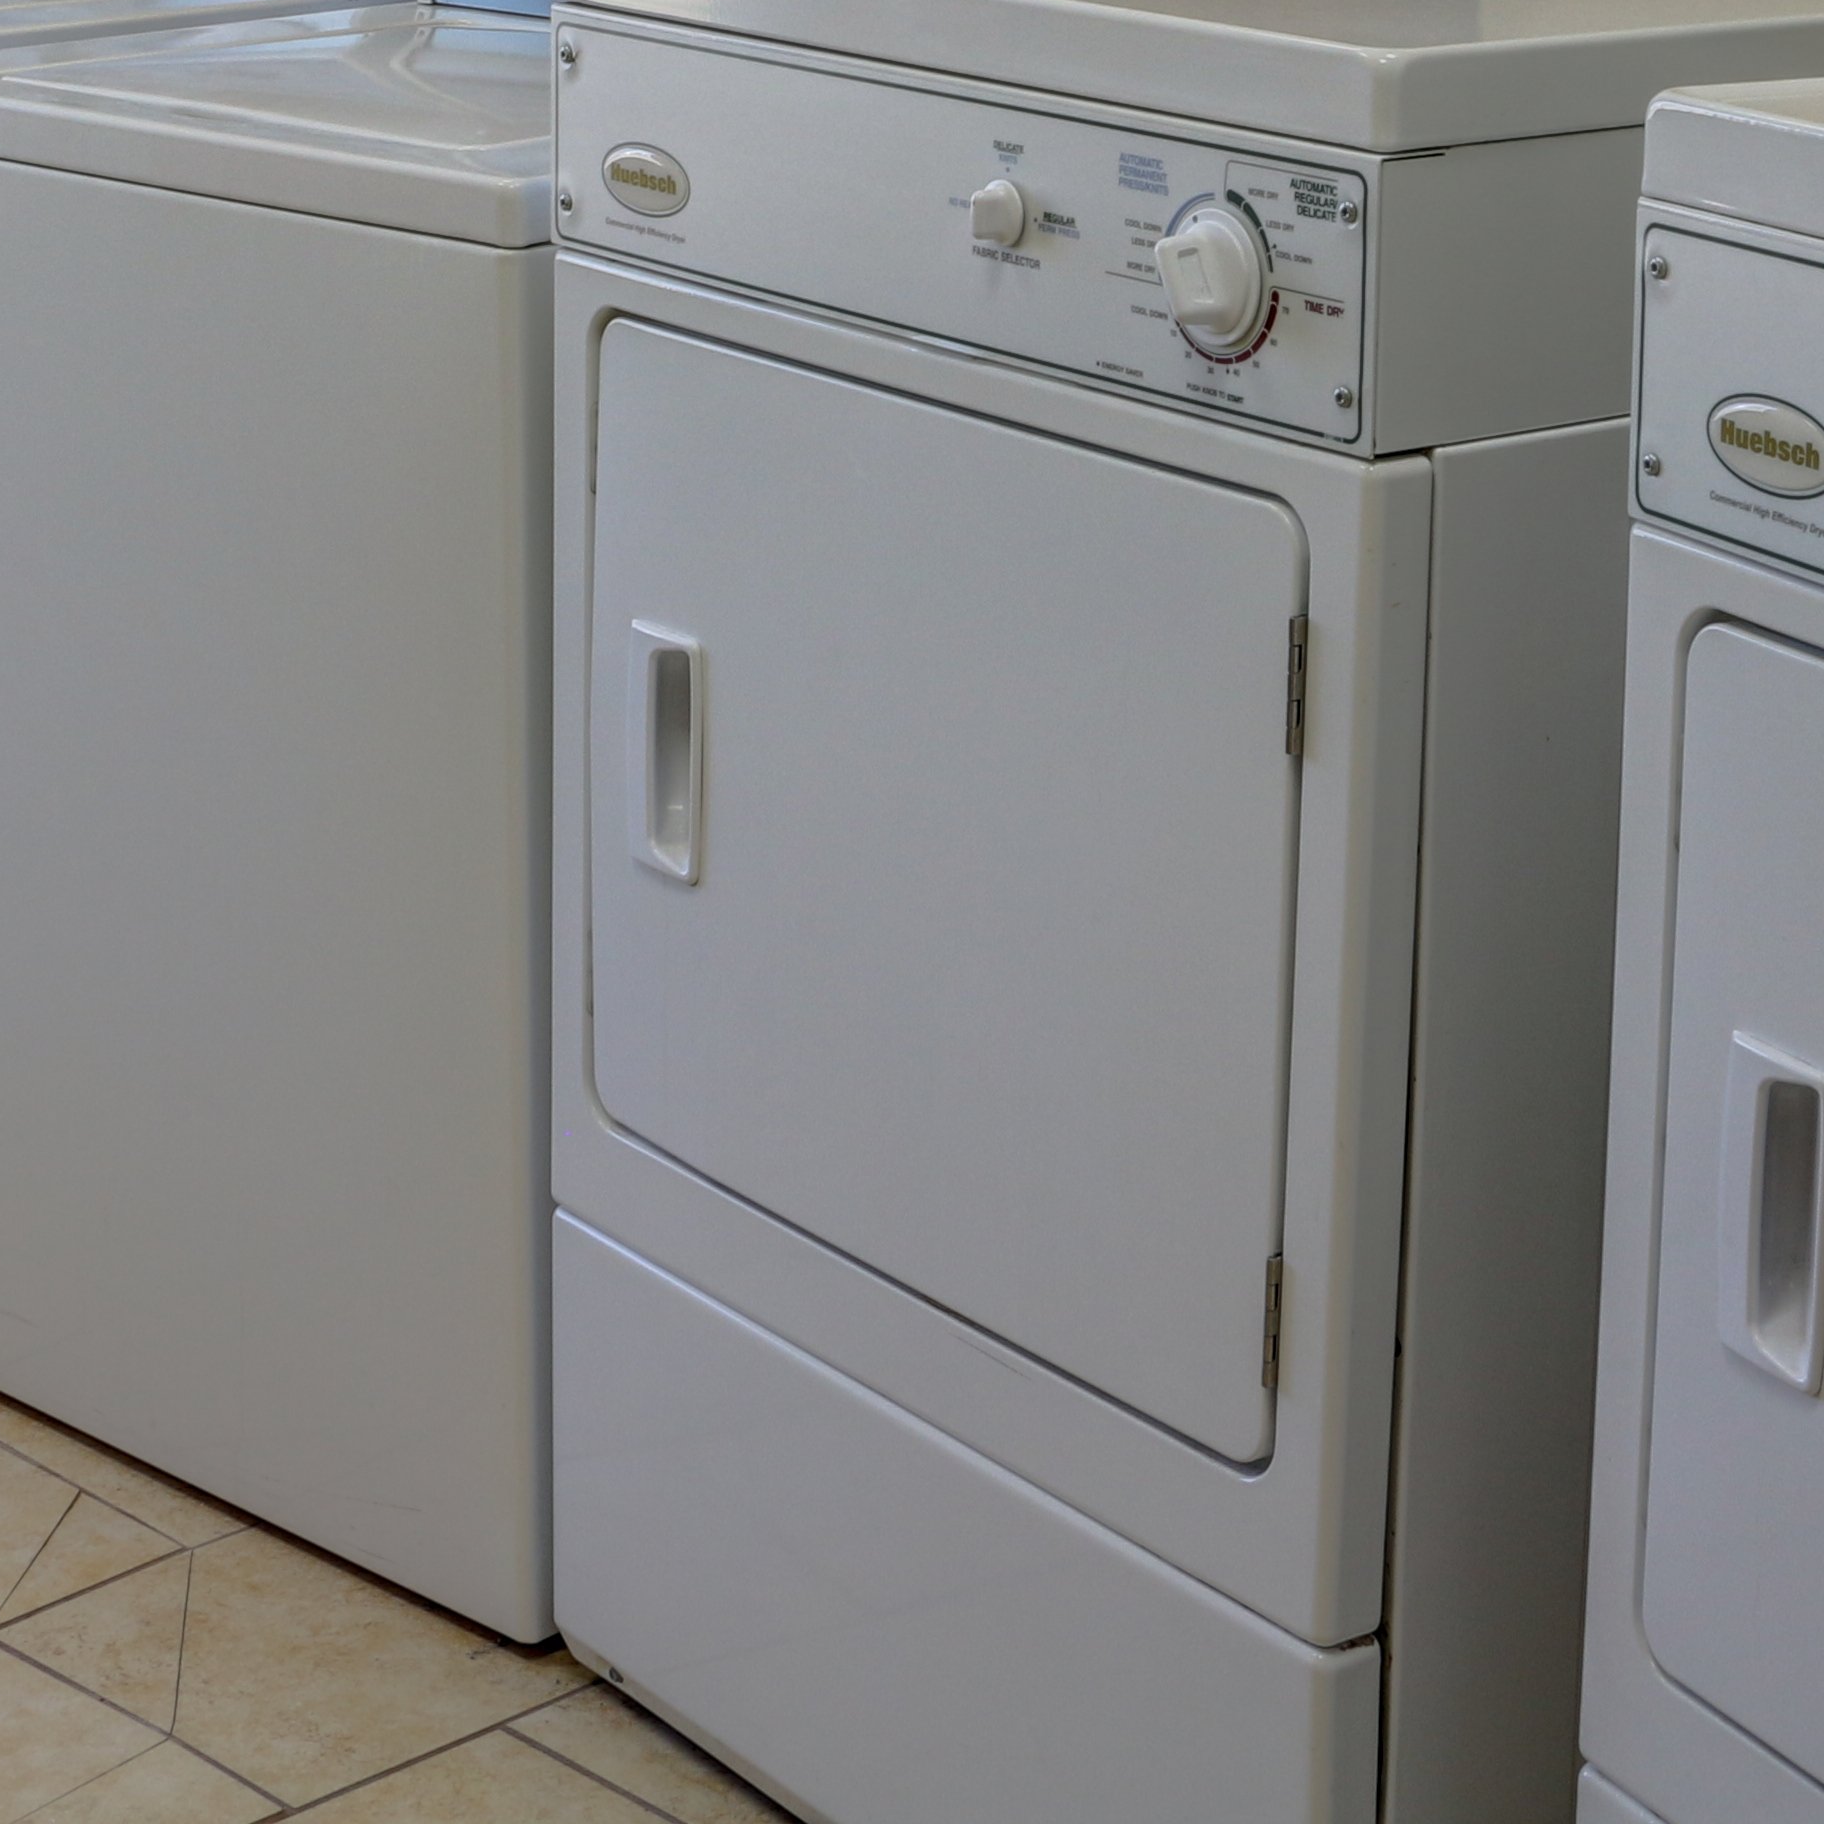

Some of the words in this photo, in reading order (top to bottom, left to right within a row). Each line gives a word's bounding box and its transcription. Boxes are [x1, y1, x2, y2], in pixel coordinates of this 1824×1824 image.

[611, 161, 677, 195] Huebsch
[1290, 178, 1338, 197] AUTOMATIC
[1297, 204, 1336, 222] DELICATE
[1001, 251, 1041, 270] SELECTOR
[1304, 300, 1324, 314] TIME
[1326, 304, 1344, 318] DRY
[1720, 418, 1820, 471] Huebsch
[1709, 490, 1752, 512] Commercial
[1753, 504, 1770, 519] High
